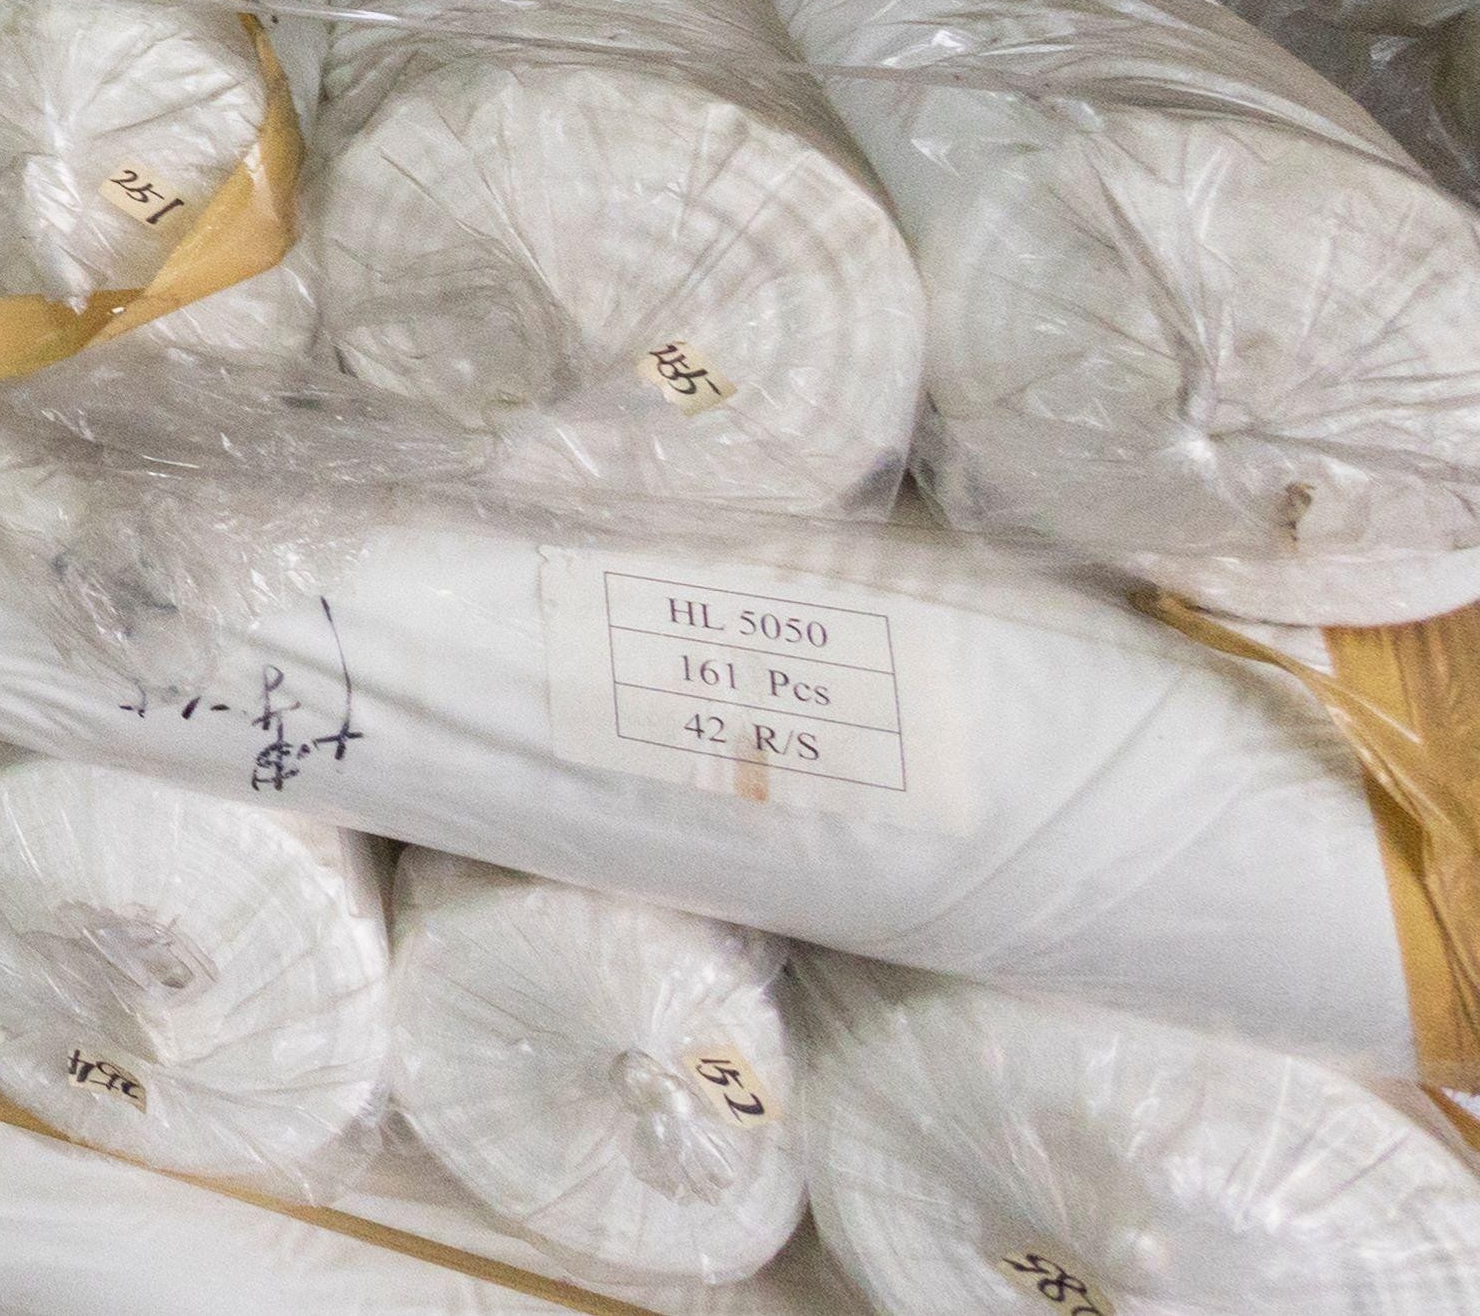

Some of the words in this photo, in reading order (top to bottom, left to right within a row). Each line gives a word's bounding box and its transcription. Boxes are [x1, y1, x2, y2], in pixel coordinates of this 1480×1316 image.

[666, 596, 726, 632] HL
[738, 610, 829, 649] 5050
[681, 654, 738, 690] 161
[767, 668, 832, 707] Pcs
[683, 712, 727, 744] 42
[752, 723, 821, 762] R/S
[695, 1058, 765, 1123] 152
